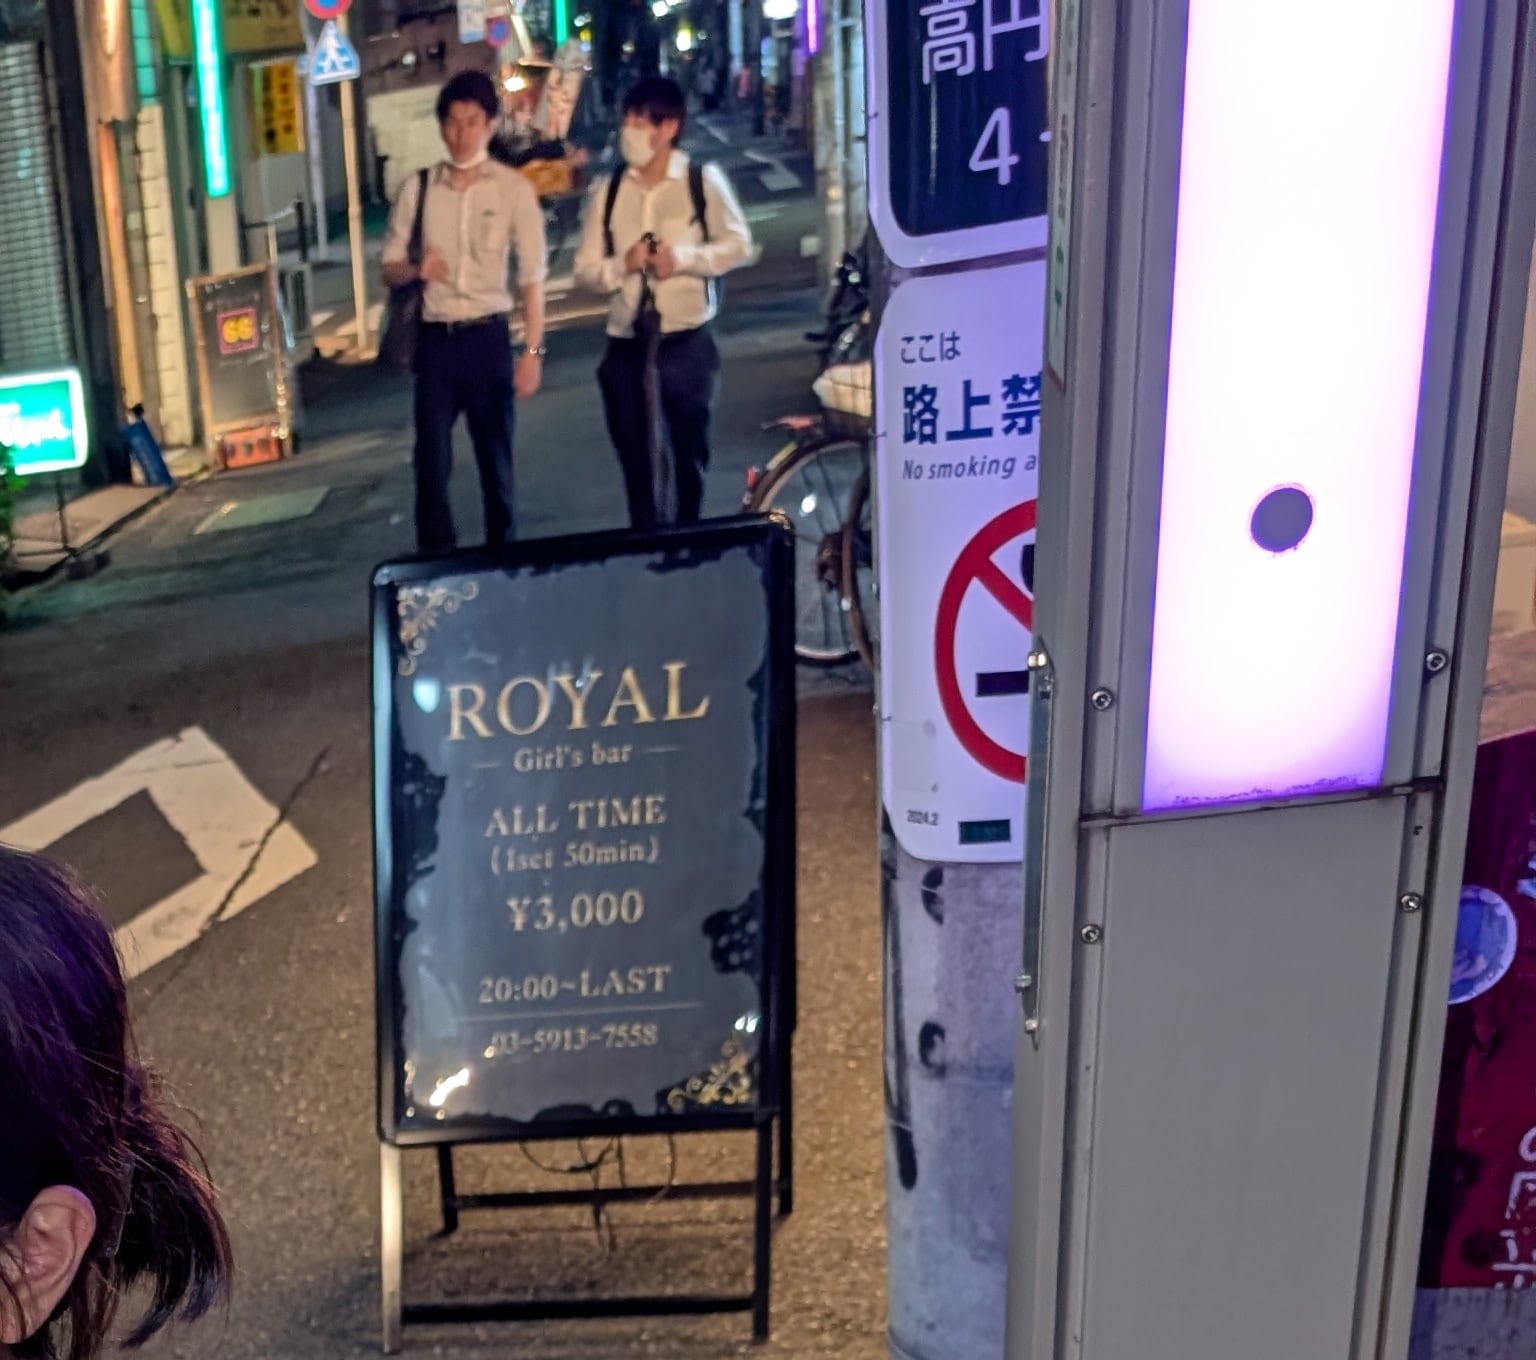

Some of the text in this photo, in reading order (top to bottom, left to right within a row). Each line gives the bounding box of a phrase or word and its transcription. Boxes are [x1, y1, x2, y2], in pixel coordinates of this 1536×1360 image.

[919, 0, 1049, 85] 高円
[900, 331, 961, 364] ここは
[902, 371, 1042, 445] 路上禁
[903, 459, 924, 480] No
[928, 455, 1017, 480] smoking
[447, 660, 711, 741] ROYAL
[514, 740, 634, 773] Girl's bar
[484, 793, 668, 838] ALL TIME
[563, 835, 660, 868] 50min)
[507, 888, 645, 933] ¥3,000
